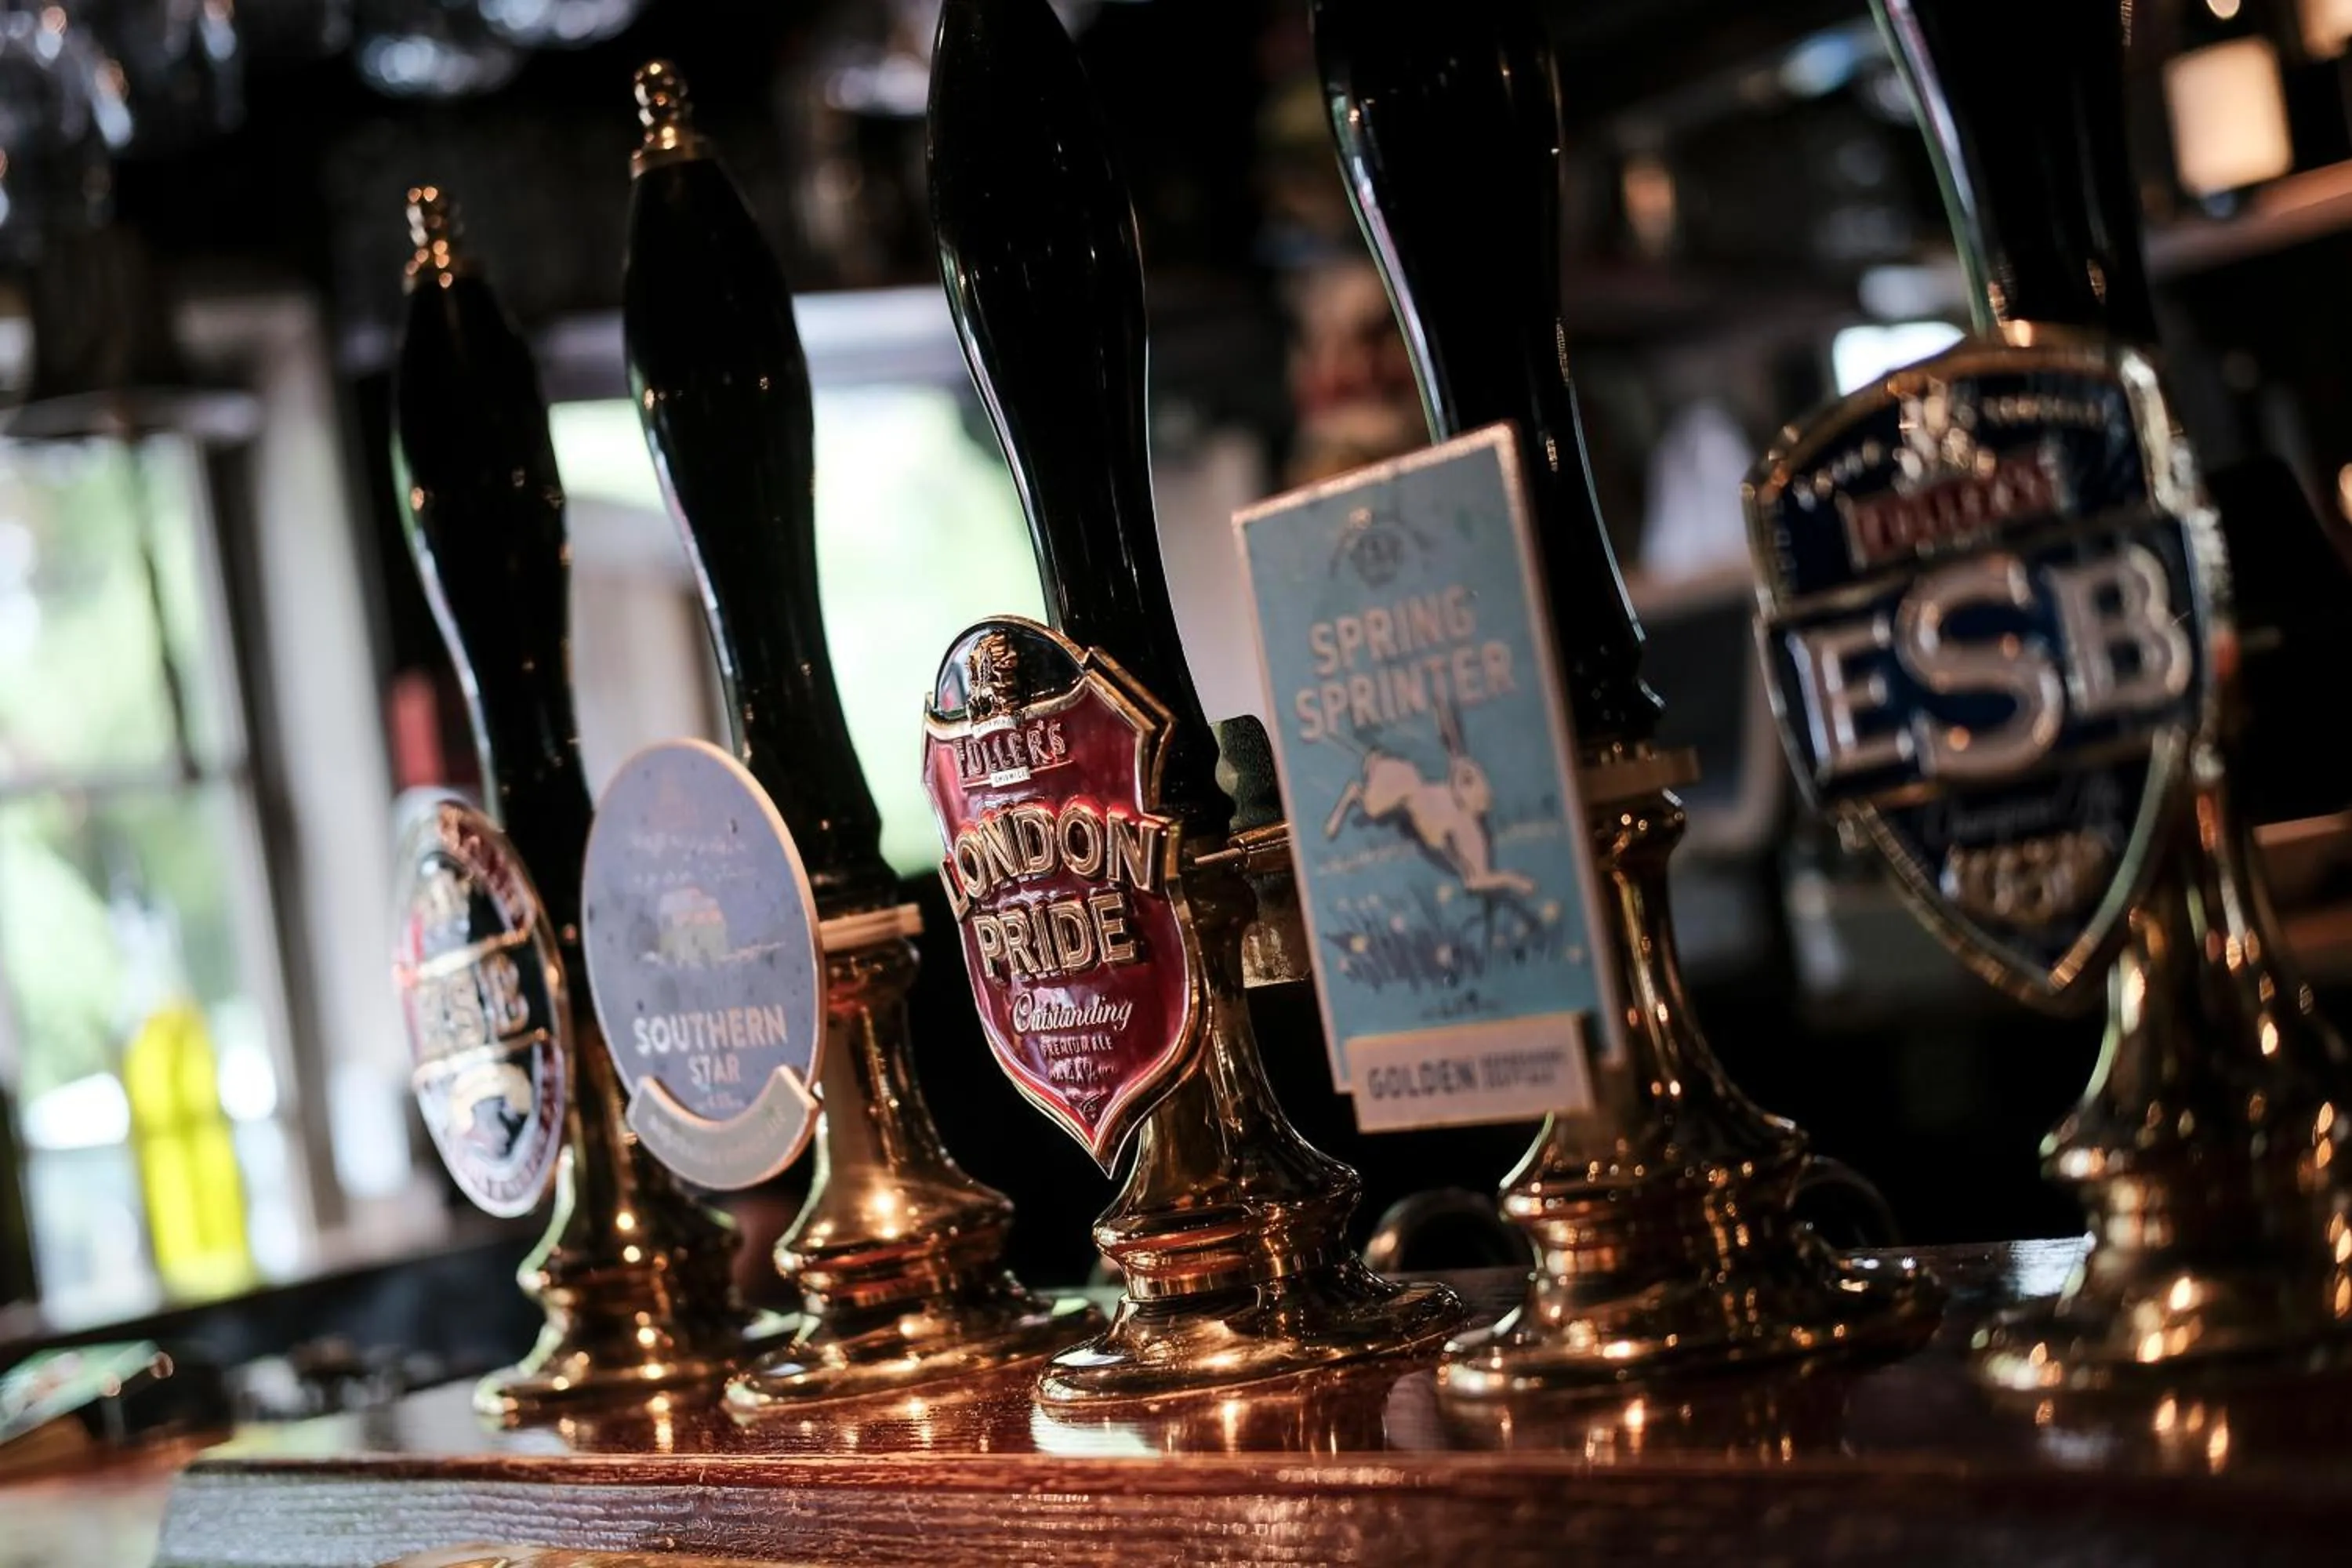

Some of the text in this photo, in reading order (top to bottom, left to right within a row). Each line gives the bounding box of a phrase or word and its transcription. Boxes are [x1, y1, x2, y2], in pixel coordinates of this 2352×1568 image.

[1309, 585, 1477, 677] SPRING
[1785, 543, 2192, 779] ESB
[1295, 641, 1518, 743] SPRINTER
[938, 800, 1165, 920] LONDON
[971, 892, 1137, 979] PRIDE
[633, 1004, 788, 1056] SOUTHERN
[1012, 992, 1132, 1032] Outstanding
[688, 1054, 741, 1087] STAR
[1368, 1059, 1476, 1101] GOLDEN
